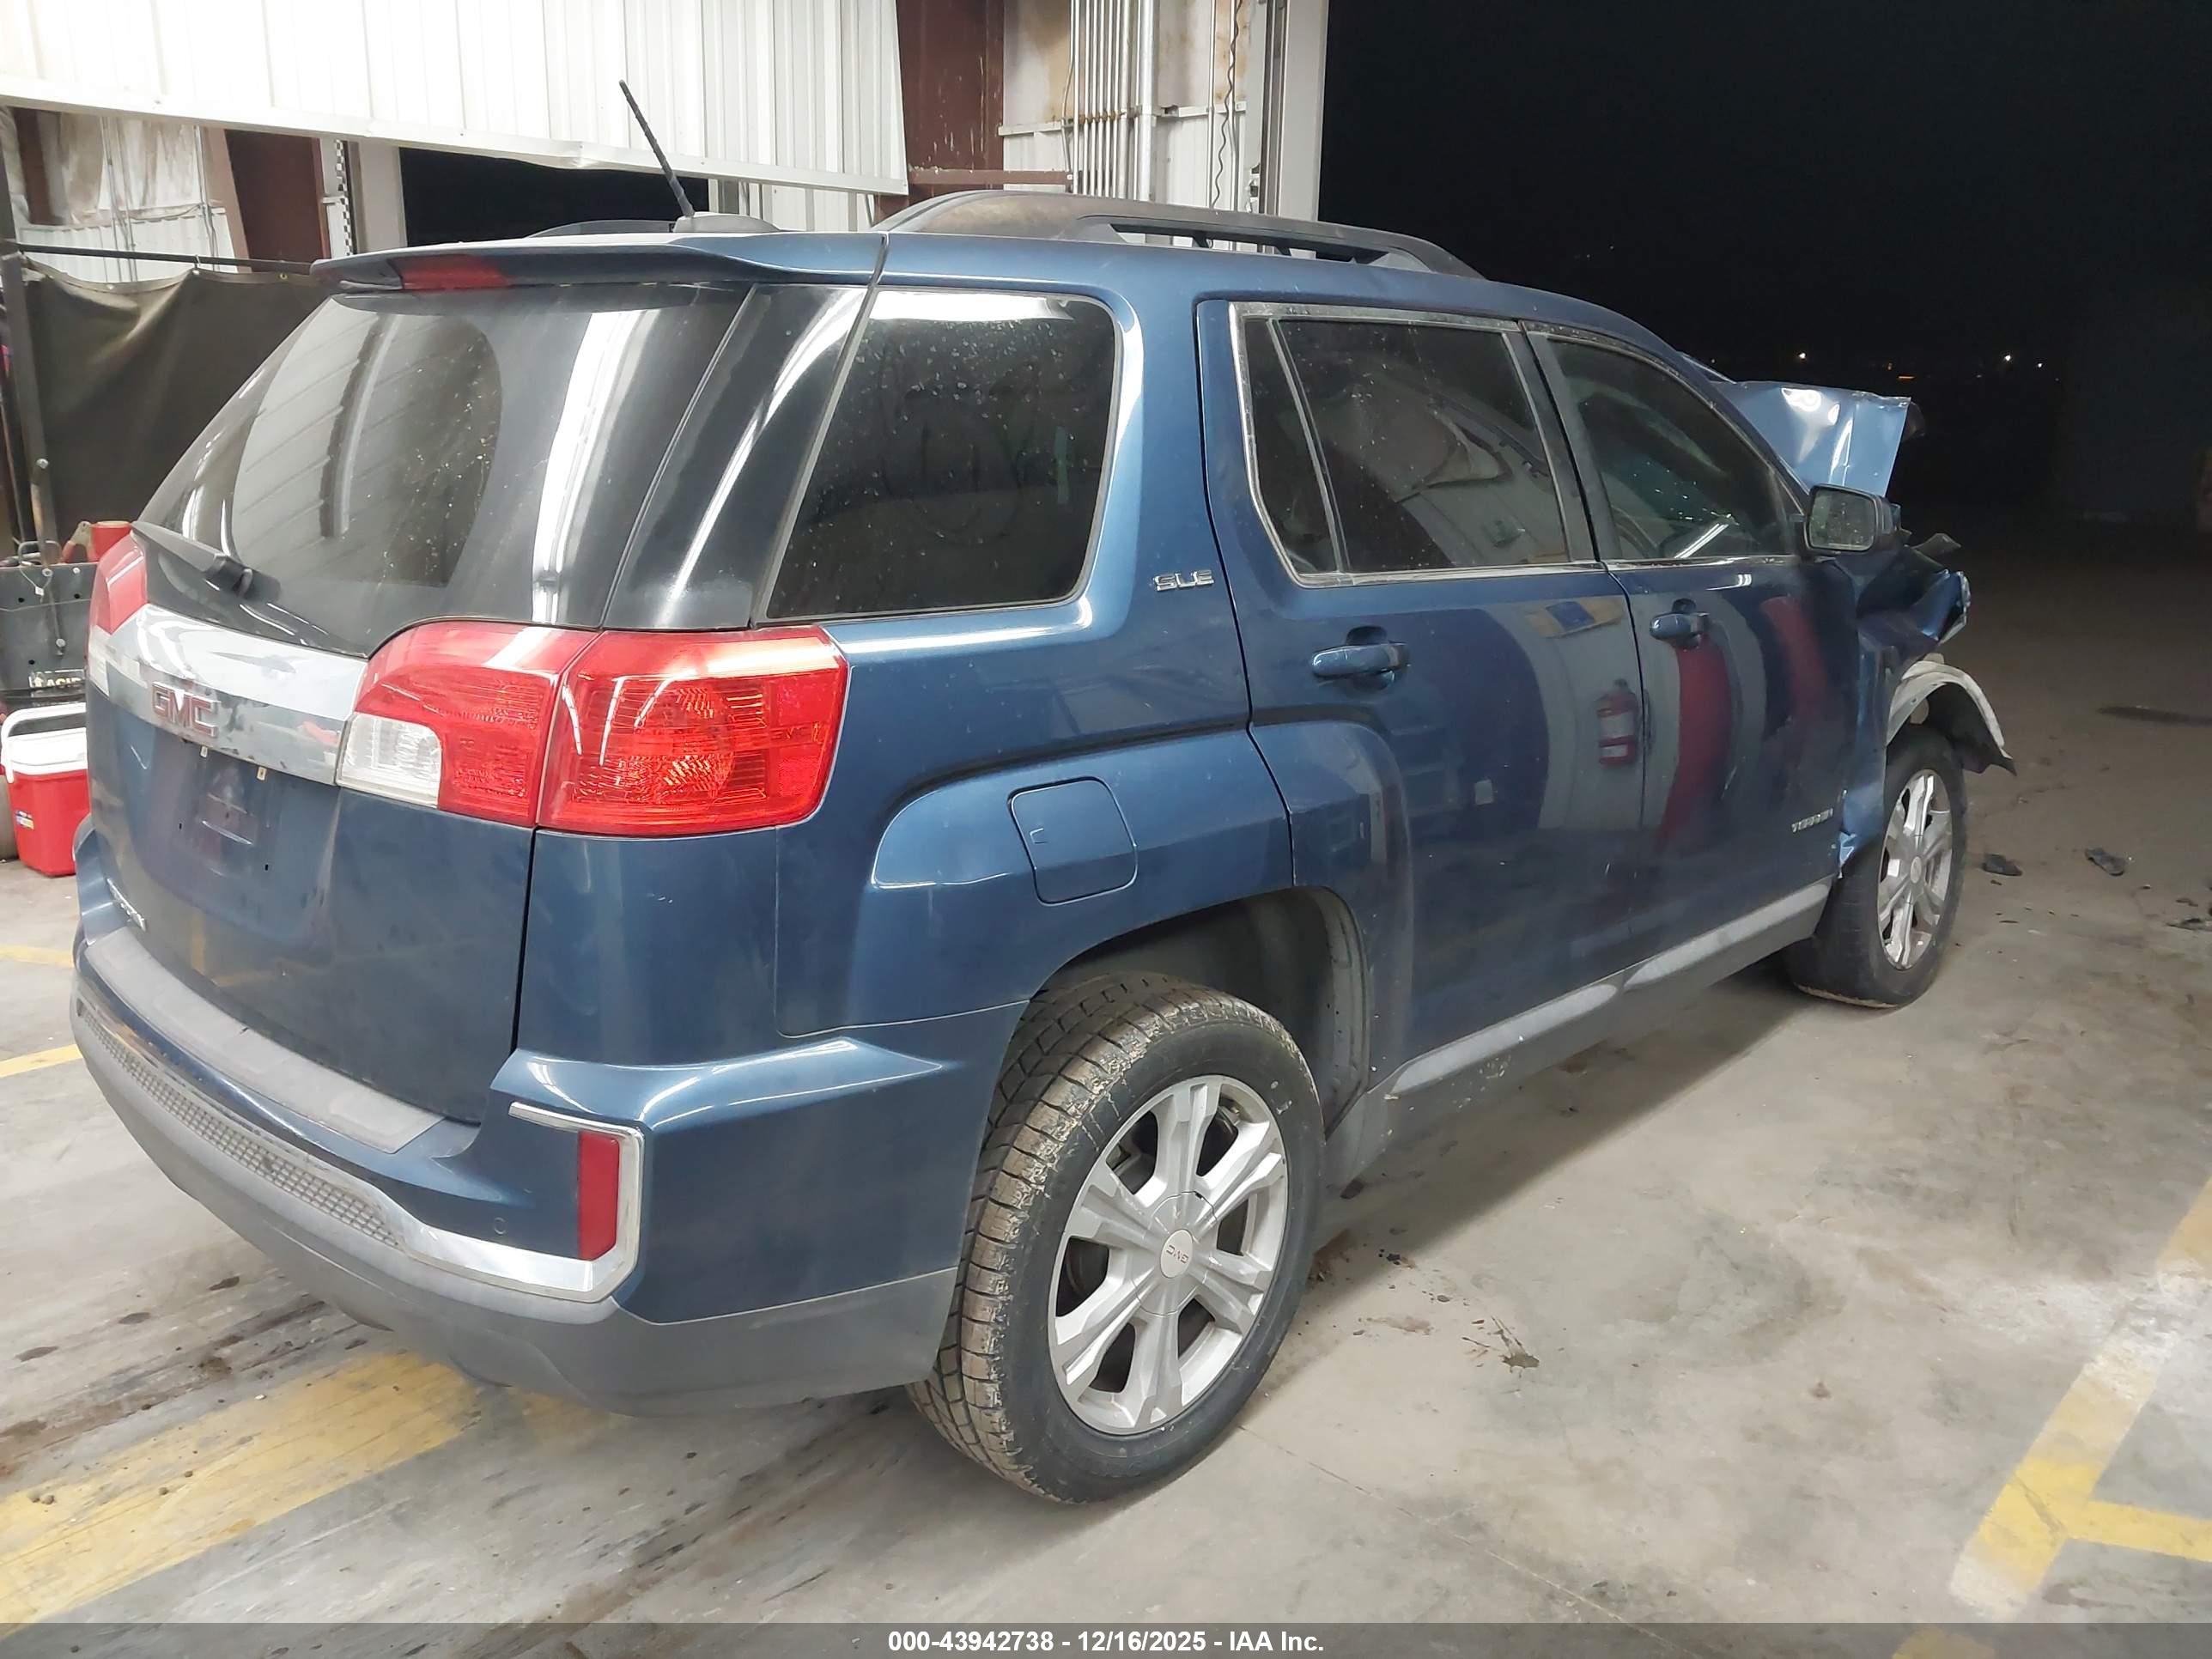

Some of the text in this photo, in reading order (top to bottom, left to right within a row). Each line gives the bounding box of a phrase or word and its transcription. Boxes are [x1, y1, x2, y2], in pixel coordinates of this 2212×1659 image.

[1152, 569, 1214, 592] SLE
[151, 681, 221, 738] GMC
[1165, 1244, 1189, 1264] GMC
